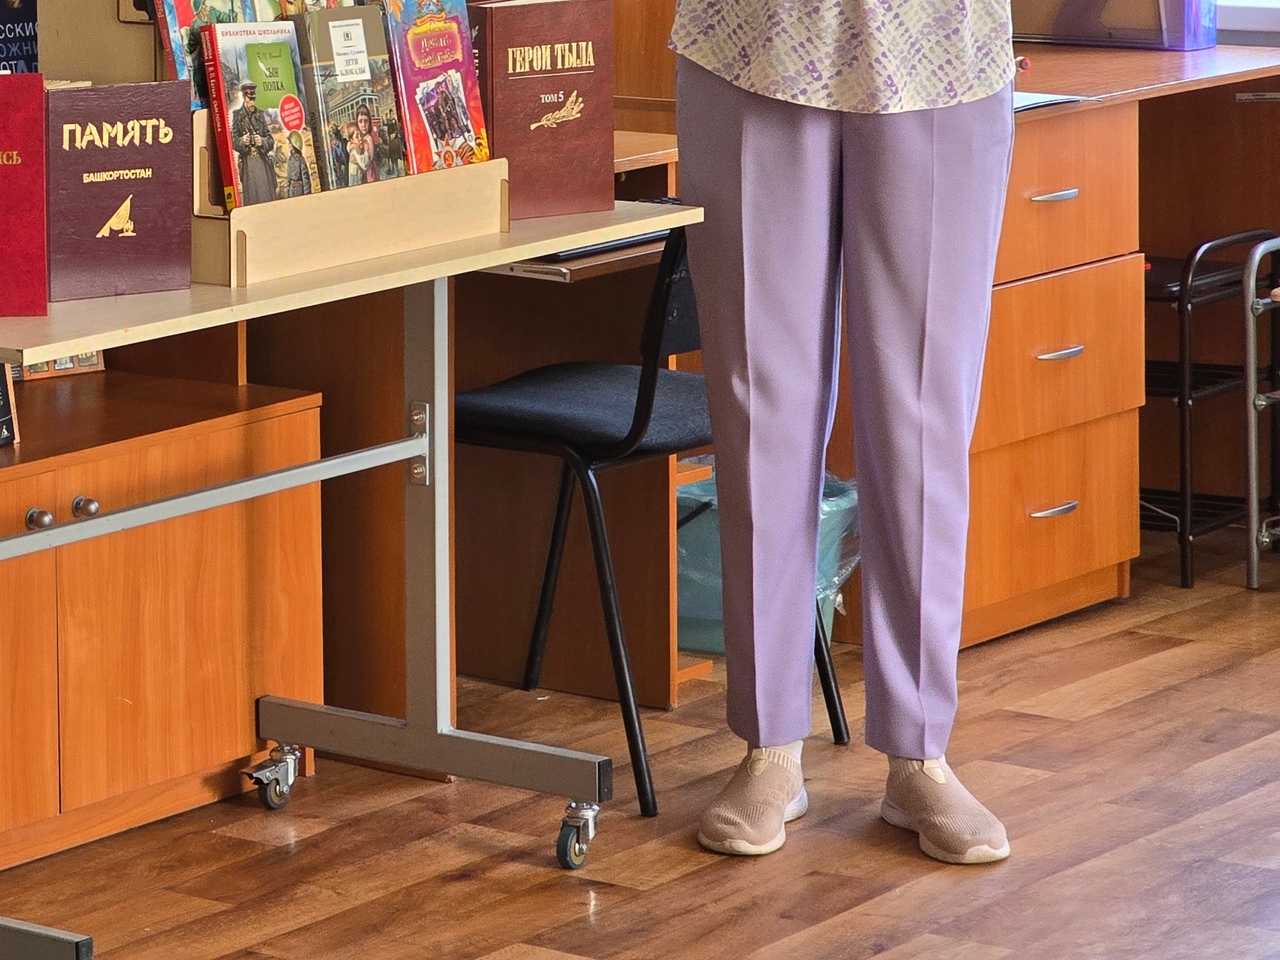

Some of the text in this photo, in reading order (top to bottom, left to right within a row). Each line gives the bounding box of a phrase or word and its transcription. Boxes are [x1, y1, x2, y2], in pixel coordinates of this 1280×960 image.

[221, 28, 291, 38] БИБЛИОТЕКА ШКОЛЬНИКА
[344, 58, 359, 67] ДЕТИ
[507, 40, 596, 74] ГЕРОИ ТЫЛА
[263, 81, 286, 92] ПОЛКА
[540, 89, 565, 103] ТОМ 5
[62, 117, 174, 152] ПАМЯТЬ
[82, 167, 152, 183] БАШКОРТОСТАН
